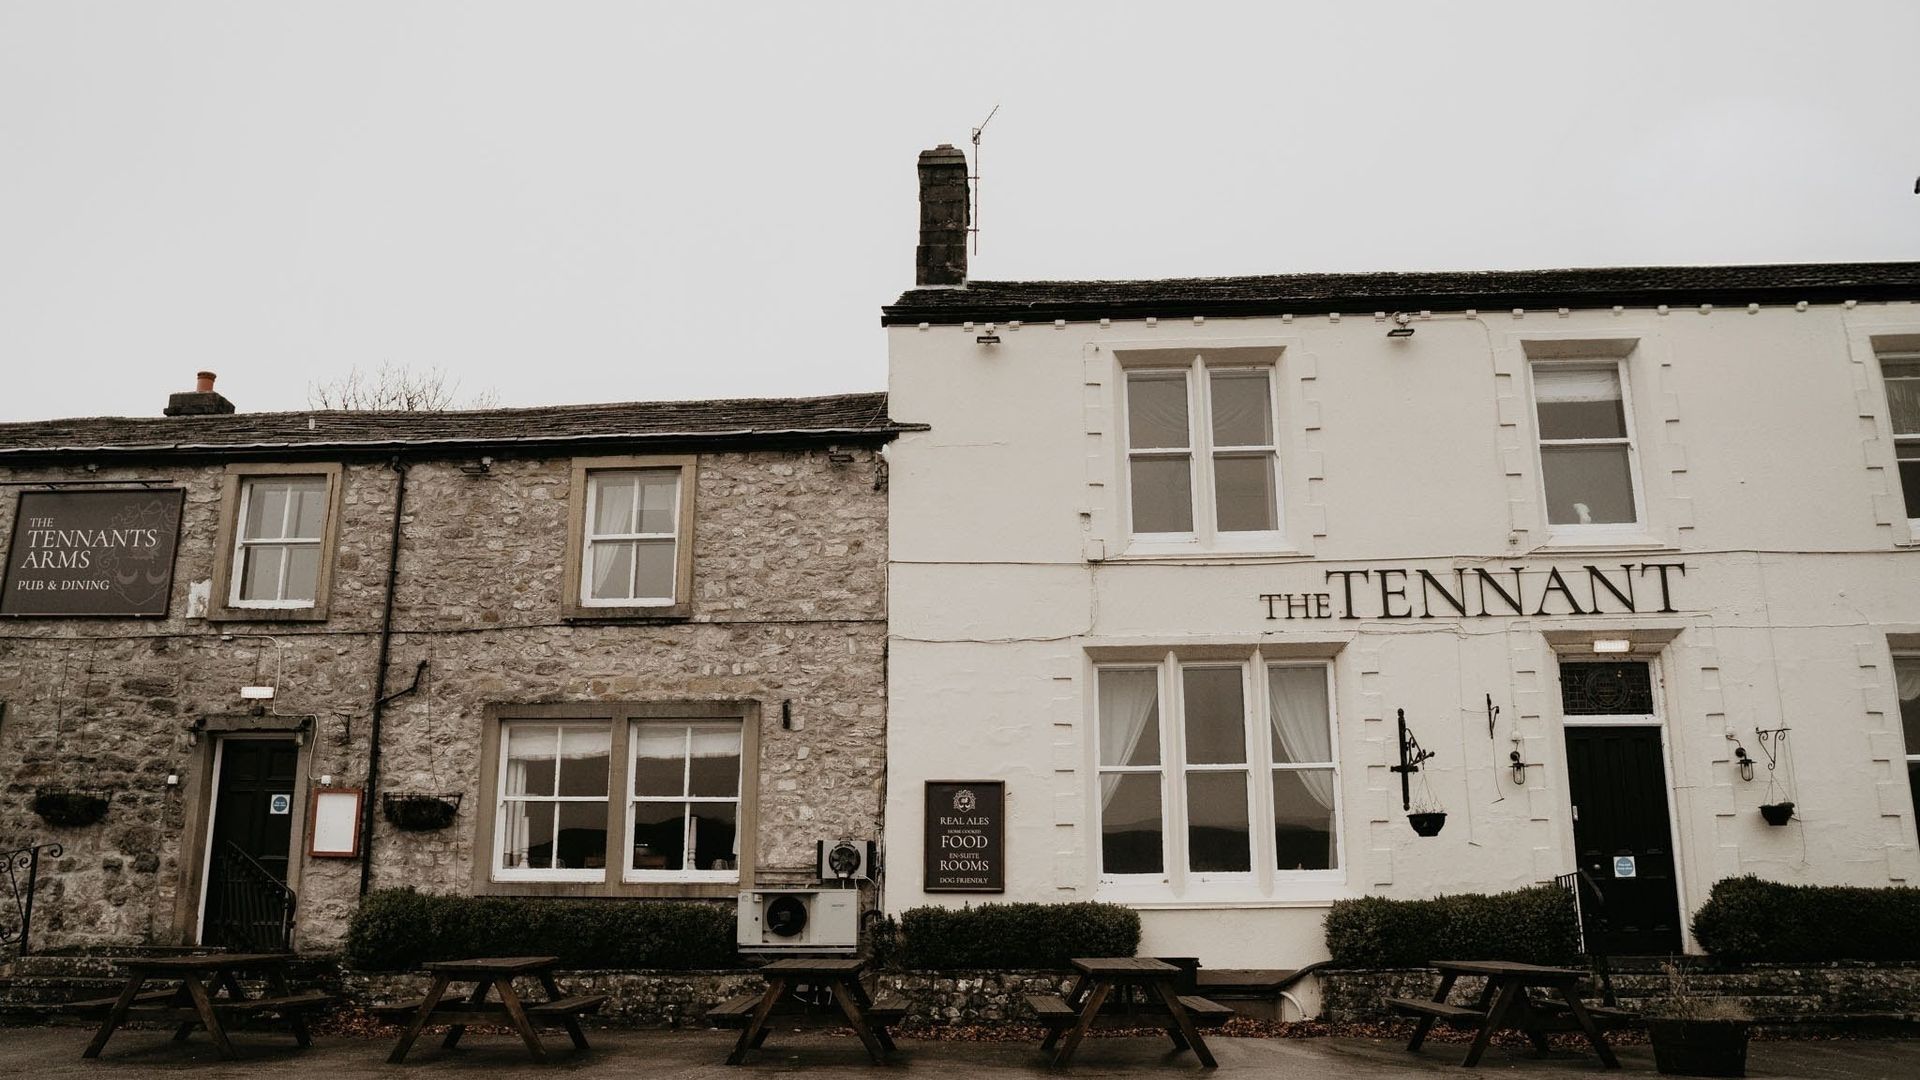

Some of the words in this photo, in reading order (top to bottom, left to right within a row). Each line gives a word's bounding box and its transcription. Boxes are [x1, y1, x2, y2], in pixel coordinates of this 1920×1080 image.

[29, 517, 54, 528] THE
[27, 528, 158, 548] TENNANTS
[20, 550, 91, 569] ARMS
[17, 580, 44, 591] PUB
[47, 580, 57, 591] &
[61, 580, 110, 591] DINING
[1259, 593, 1333, 620] THE
[1325, 562, 1687, 620] TENNANT
[940, 816, 965, 826] REAL
[966, 816, 990, 826] ALES
[941, 835, 988, 849] FOOD
[940, 860, 989, 871] ROOMS
